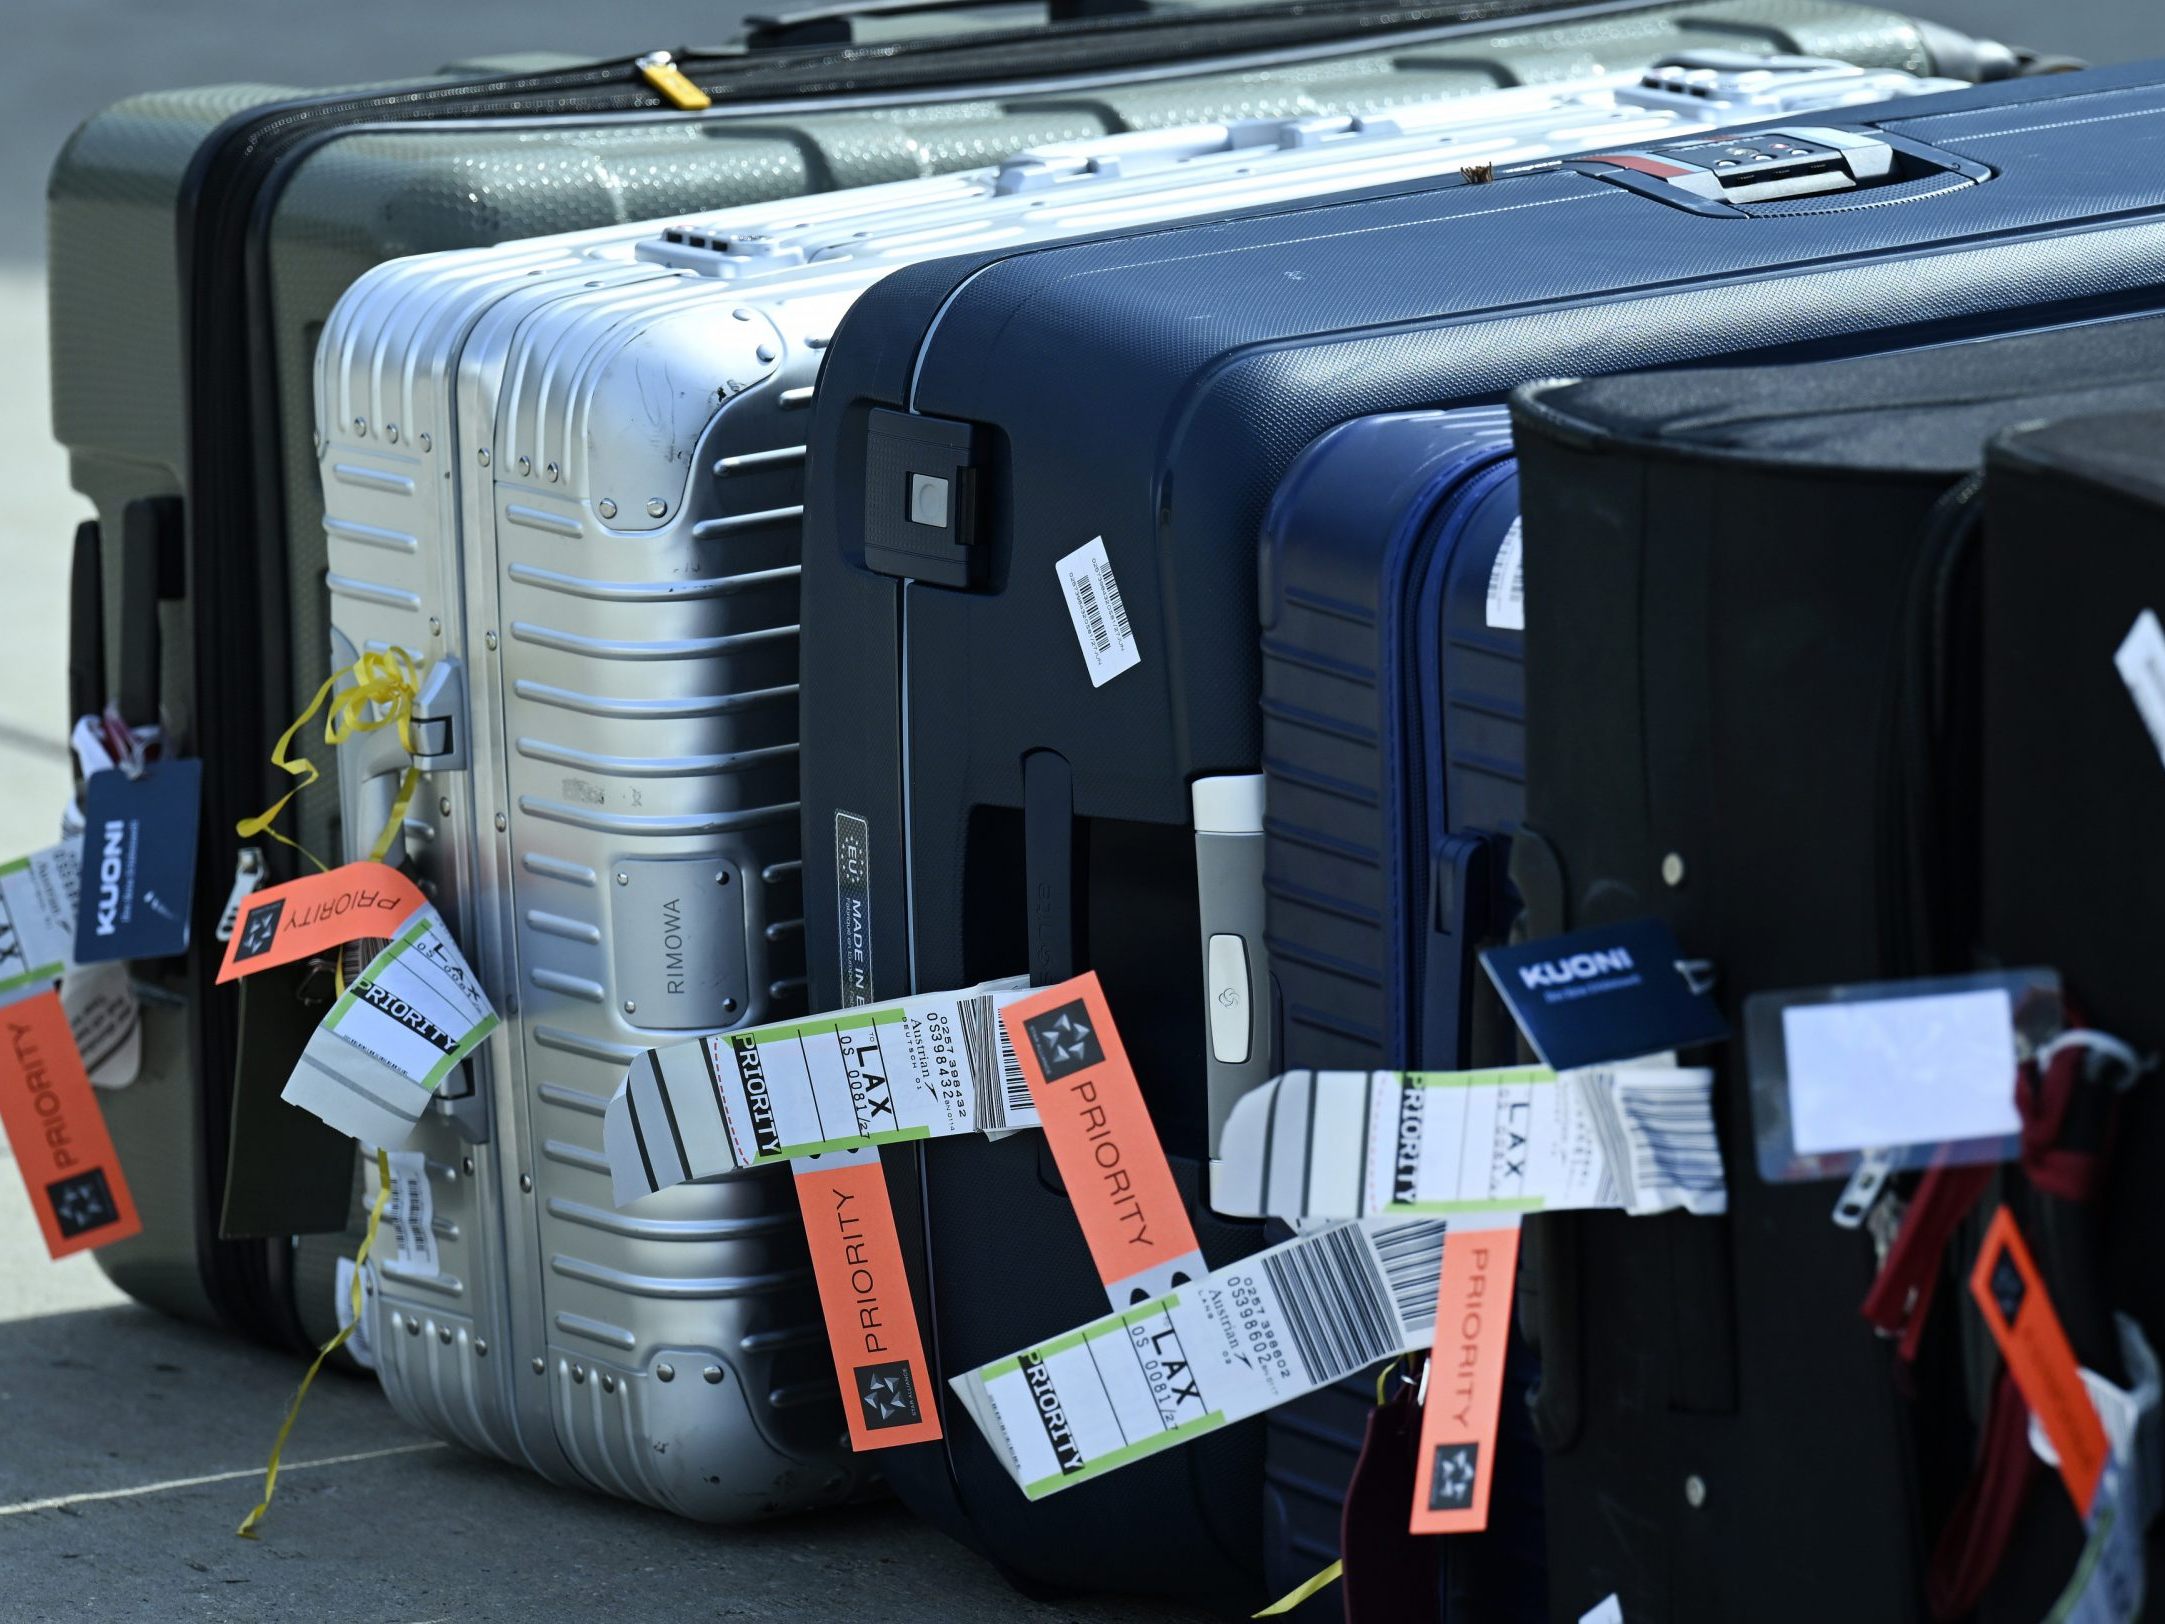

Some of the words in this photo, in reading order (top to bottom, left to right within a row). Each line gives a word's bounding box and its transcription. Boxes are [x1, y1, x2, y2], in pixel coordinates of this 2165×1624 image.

[96, 819, 125, 936] KUONI
[284, 889, 401, 932] PRIORITY
[663, 898, 685, 994] RIMOWA
[852, 899, 864, 963] MADE
[1518, 947, 1634, 990] KUONI
[433, 943, 480, 1001] LAX
[854, 969, 866, 989] IN
[353, 978, 458, 1051] PRIORITY
[901, 1016, 917, 1069] DEUTSCH
[911, 1018, 930, 1079] Austrian
[9, 1021, 78, 1172] PRIORITY
[738, 1035, 781, 1154] PRIORITY
[856, 1045, 893, 1118] LAX
[940, 1016, 954, 1054] 0257
[949, 1059, 967, 1118] 398432
[1070, 1080, 1153, 1248] PRIORITY
[1393, 1076, 1426, 1205] PRIORITY
[1503, 1102, 1530, 1178] LAX
[832, 1187, 888, 1353] PRIORITY
[1244, 1277, 1265, 1314] 0257
[1208, 1288, 1240, 1350] Austrian
[1452, 1247, 1490, 1429] PRIORITY
[1151, 1328, 1201, 1406] LAX
[1026, 1350, 1085, 1471] PRIORITY
